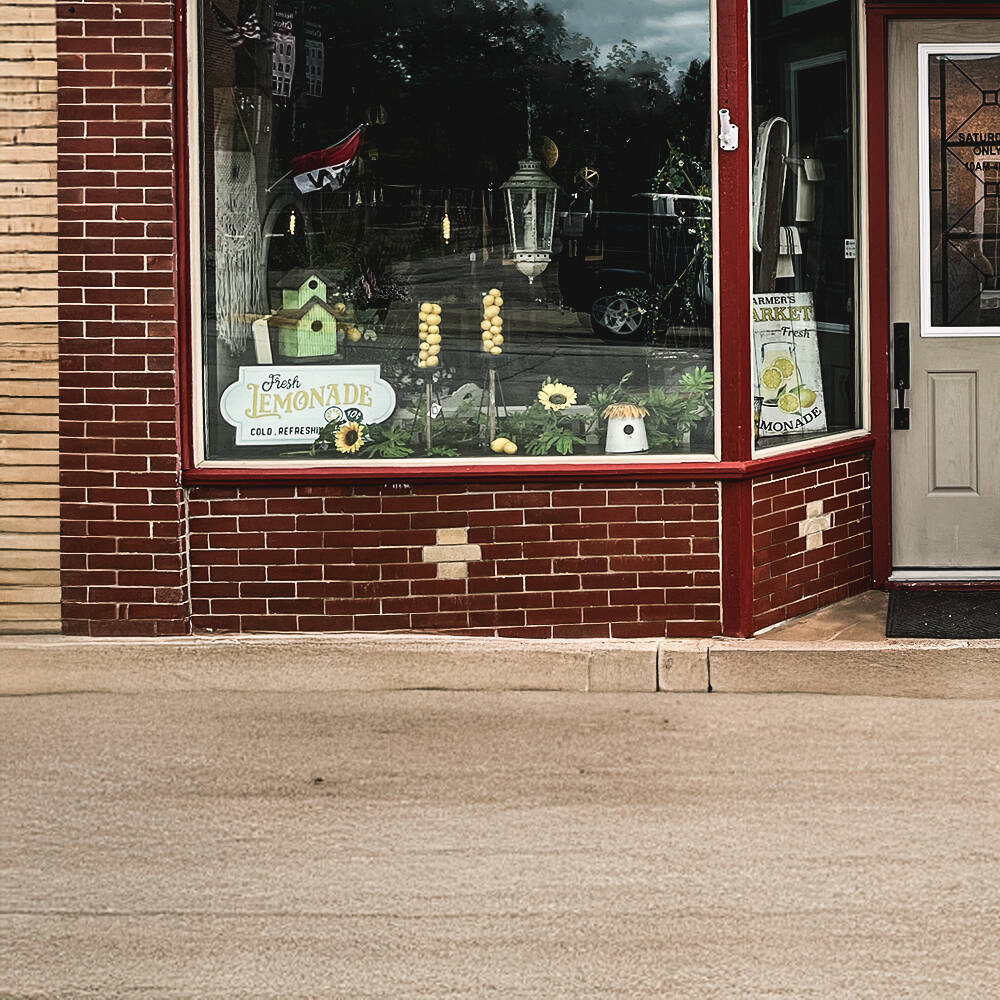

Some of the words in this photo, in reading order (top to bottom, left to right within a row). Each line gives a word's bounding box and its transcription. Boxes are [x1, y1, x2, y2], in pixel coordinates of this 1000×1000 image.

[753, 295, 796, 305] ARMER'S
[753, 305, 813, 323] ARKET
[781, 326, 811, 339] Fresh
[261, 373, 301, 392] Fresh
[244, 383, 373, 419] LEMONADE
[760, 406, 822, 432] MONADE
